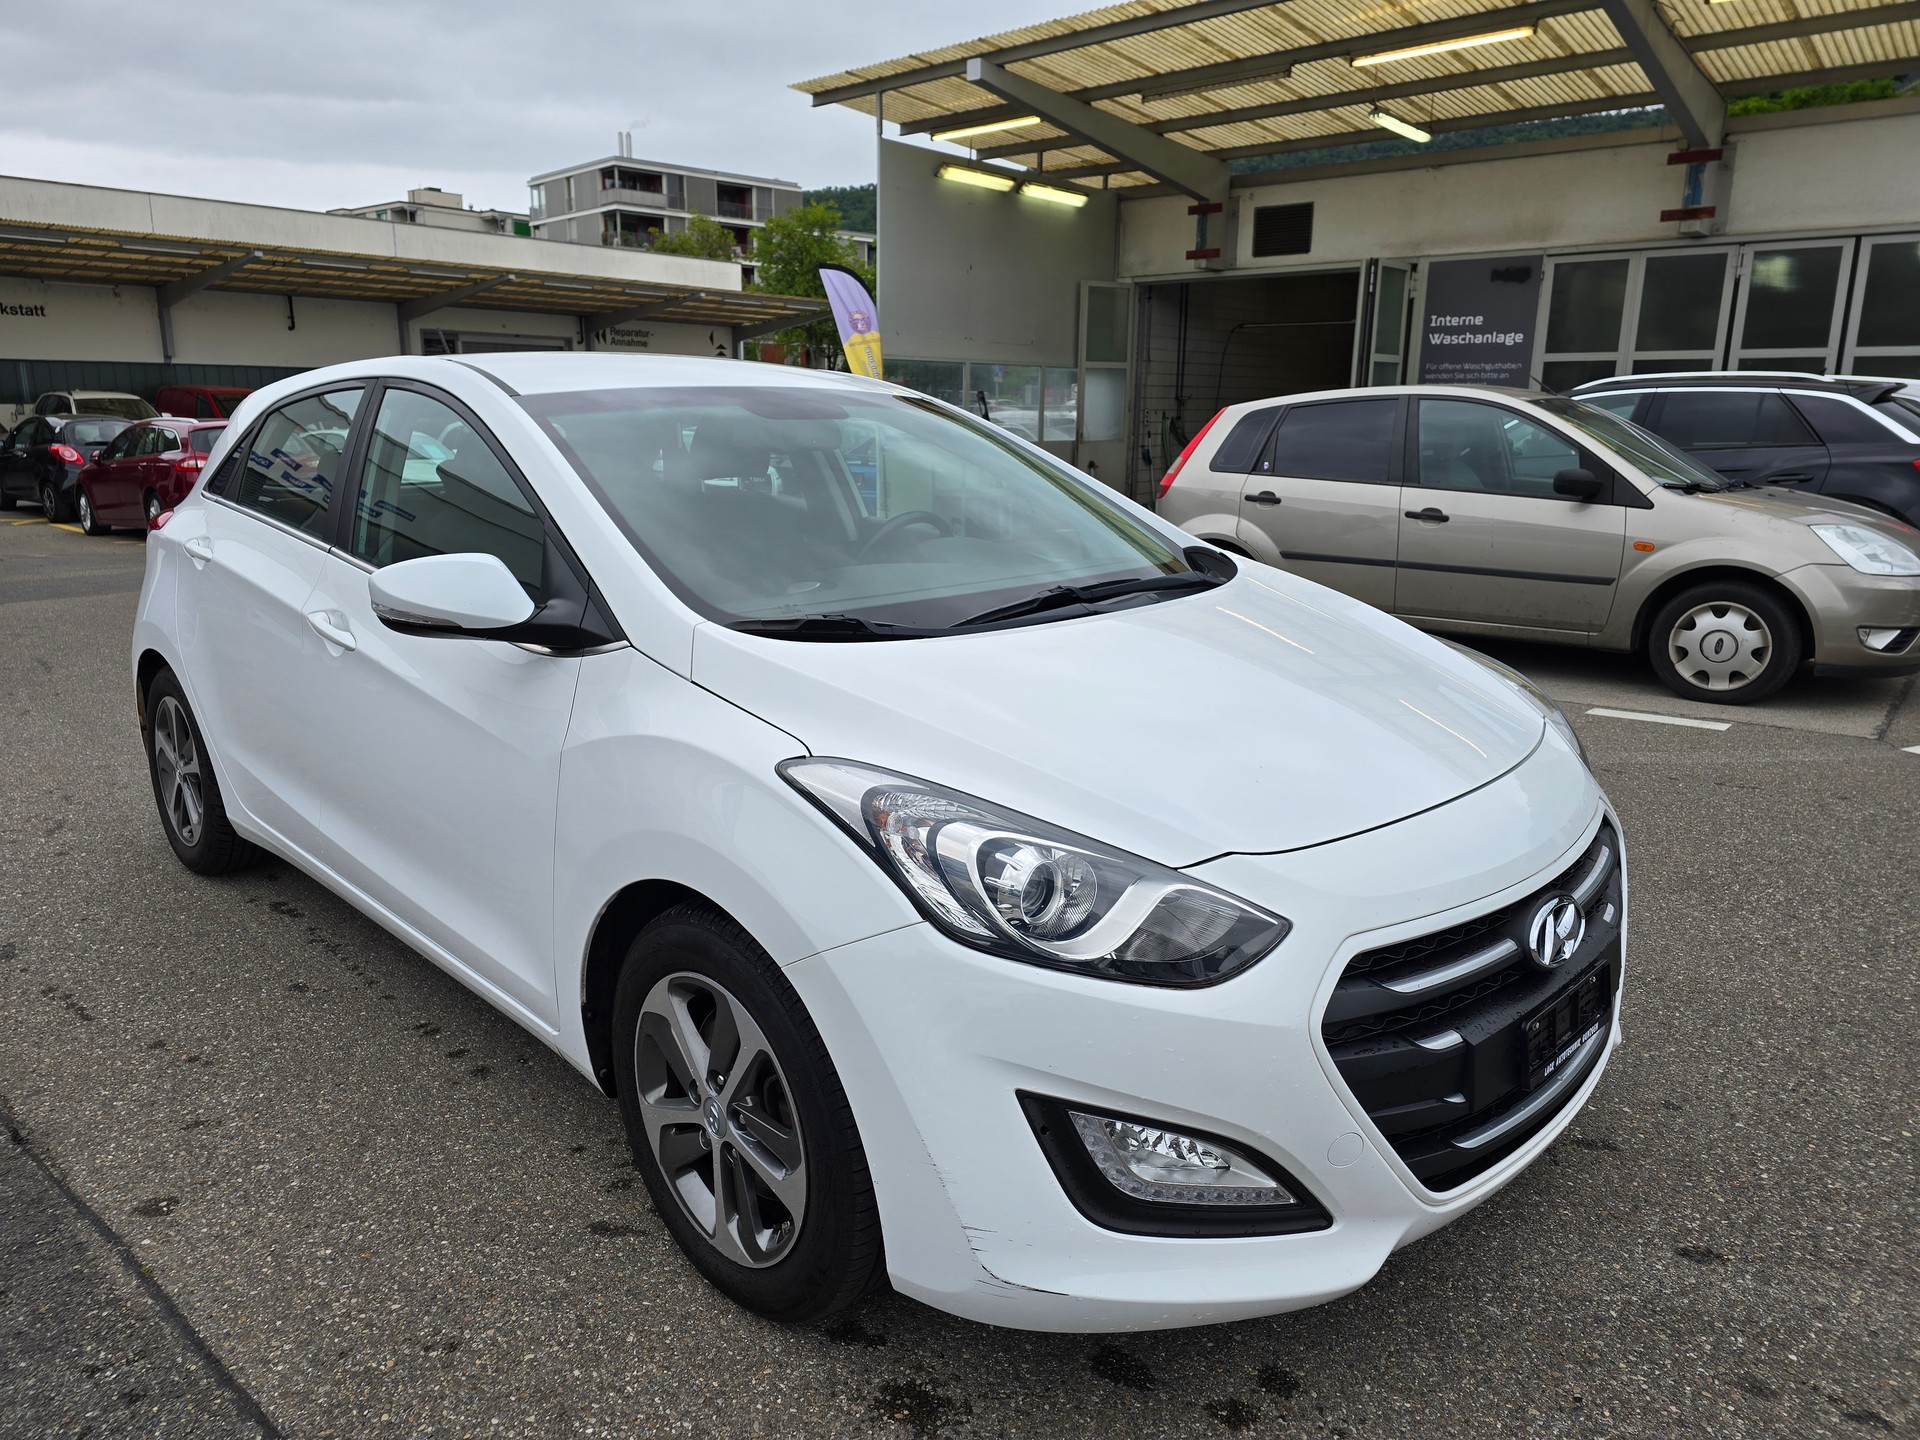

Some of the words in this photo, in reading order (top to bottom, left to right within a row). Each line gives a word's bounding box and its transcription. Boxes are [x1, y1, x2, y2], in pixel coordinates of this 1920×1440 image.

[0, 302, 46, 317] kstatt
[1430, 315, 1483, 327] Interne
[610, 336, 648, 347] Annahme
[1429, 331, 1524, 345] Waschanlage
[1425, 362, 1438, 370] Für
[1438, 362, 1462, 370] offene
[1463, 361, 1522, 371] Waschguthaben
[1465, 371, 1480, 379] sich
[1480, 371, 1498, 379] bitte
